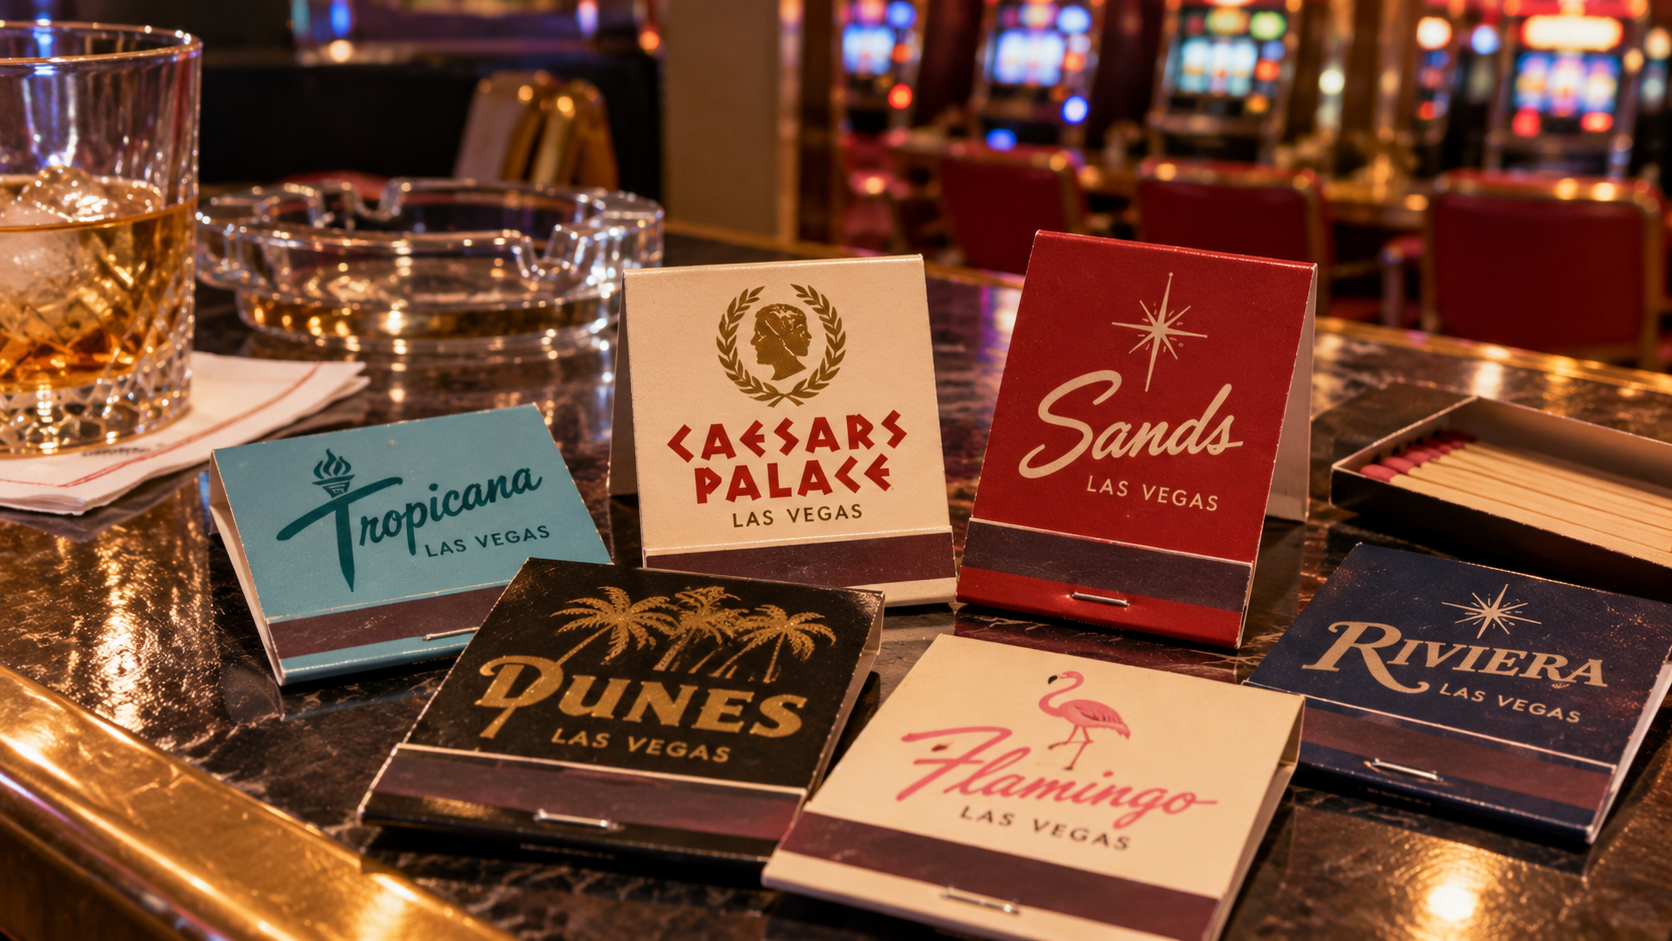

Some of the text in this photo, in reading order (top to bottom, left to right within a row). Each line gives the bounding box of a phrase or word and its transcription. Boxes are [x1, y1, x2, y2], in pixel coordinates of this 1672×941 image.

[667, 409, 907, 463] CAESARS
[1018, 369, 1244, 479] Sands
[694, 452, 892, 504] PALACE
[1086, 475, 1219, 512] LAS VEGAS
[276, 467, 543, 593] Tropicana
[424, 525, 551, 558] LAS VEGAS
[732, 503, 863, 528] LAS VEGAS
[1301, 620, 1608, 694] RIVIERA
[474, 654, 808, 740] DUNES
[1439, 682, 1581, 724] LAS VEGAS
[551, 727, 732, 764] LAS VEGAS
[896, 726, 1218, 830] Flamingo
[959, 805, 1131, 851] LAS VEGAS
